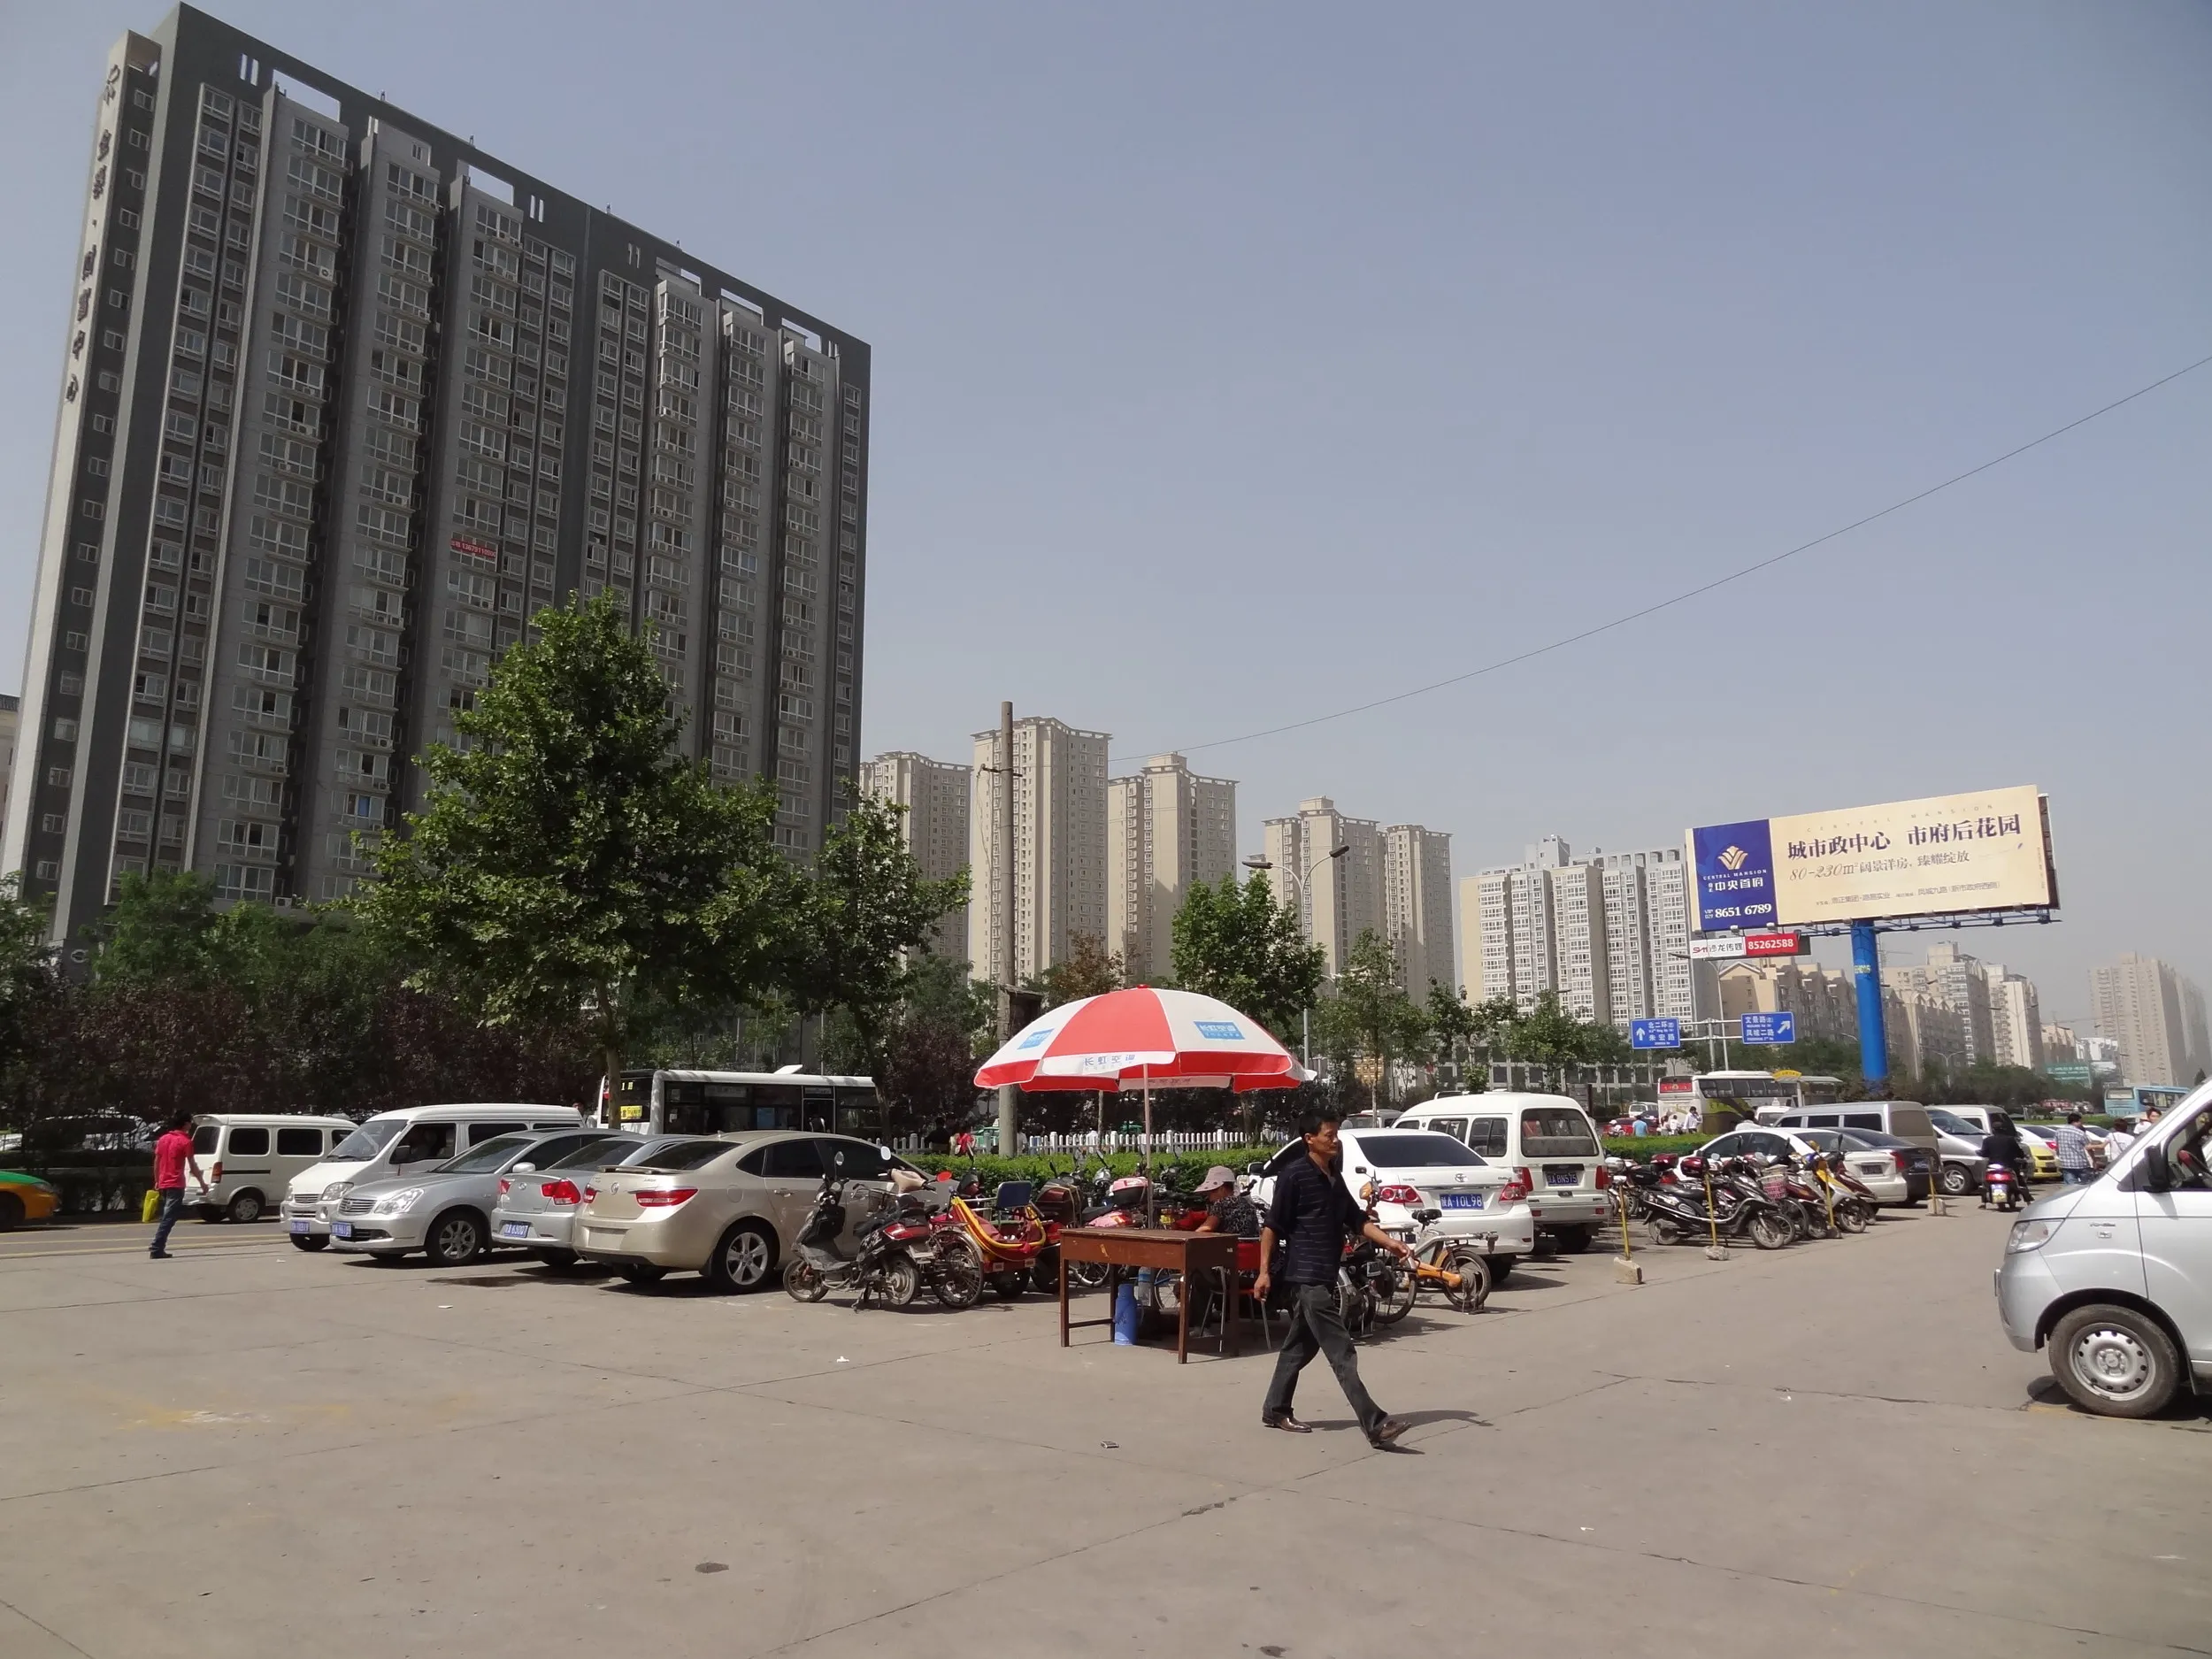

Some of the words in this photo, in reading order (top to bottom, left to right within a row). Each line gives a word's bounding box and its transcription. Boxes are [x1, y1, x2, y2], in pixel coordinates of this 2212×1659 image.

[1788, 832, 1891, 860] 城市政中心
[1906, 813, 2021, 847] 市府后花园
[1715, 877, 1763, 891] 中央首府
[1715, 908, 1741, 918] 8651
[1744, 903, 1771, 915] 6789
[1747, 939, 1793, 950] 85262588
